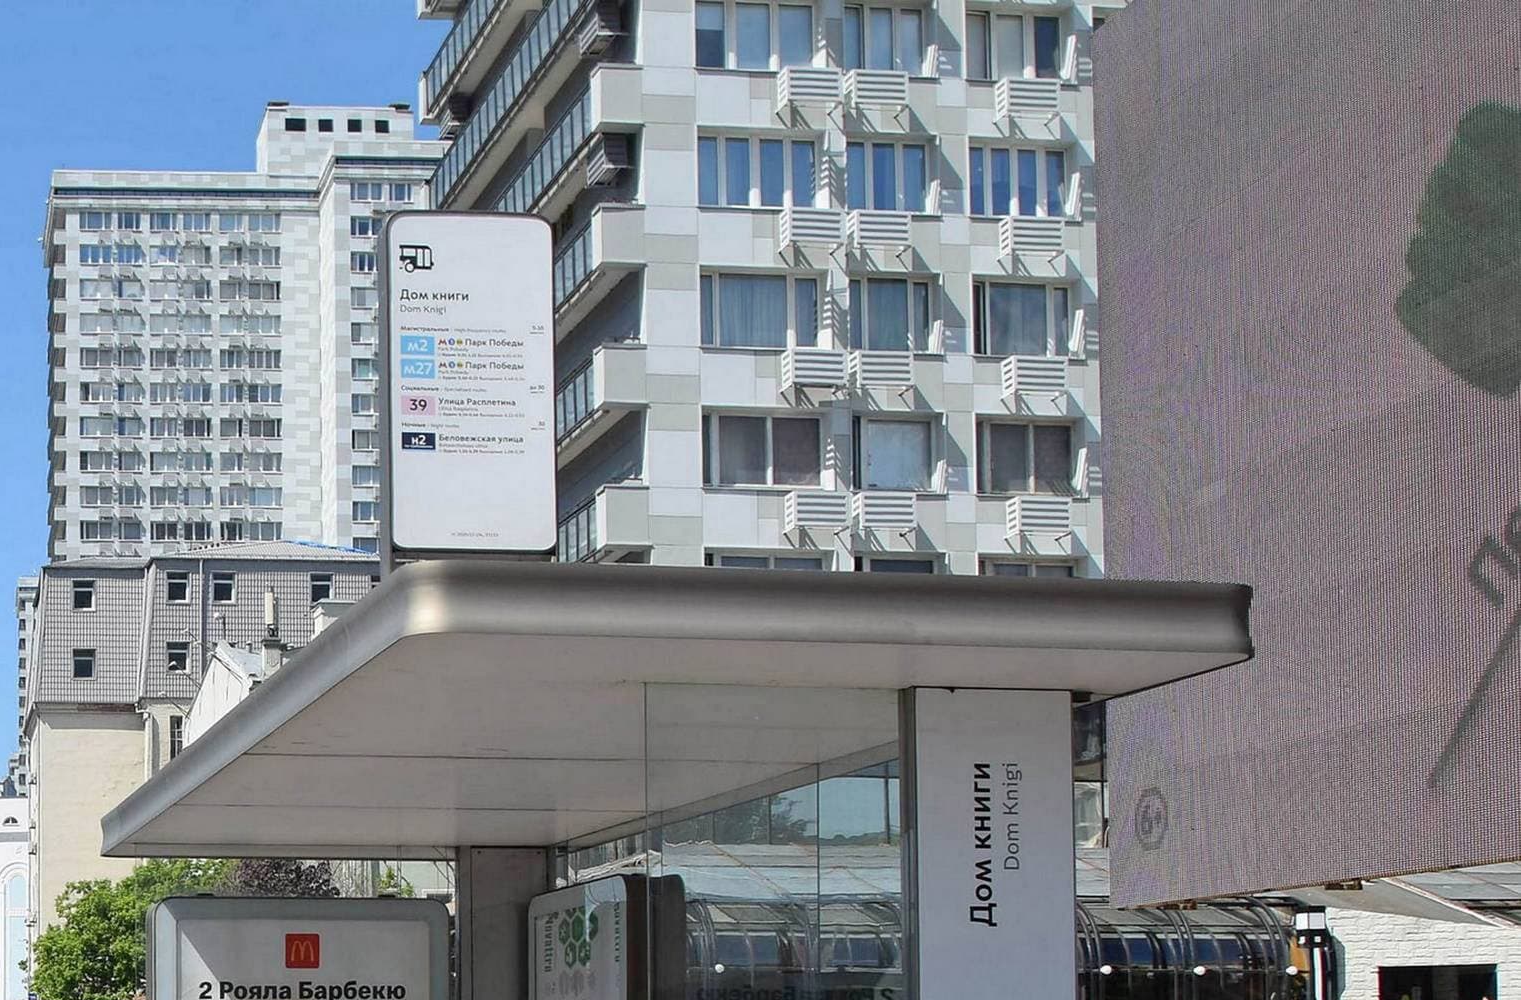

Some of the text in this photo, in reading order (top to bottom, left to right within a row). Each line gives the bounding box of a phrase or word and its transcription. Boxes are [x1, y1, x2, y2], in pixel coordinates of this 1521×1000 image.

[400, 289, 469, 301] Дом книги
[400, 305, 447, 315] Dom Knigi
[489, 339, 524, 347] Победы
[489, 362, 524, 370] Победы
[409, 399, 428, 411] 39
[438, 397, 516, 406] Улица Расплетина
[439, 434, 524, 444] Беловежская улица
[1002, 763, 1022, 870] Dom Knigi
[970, 763, 997, 927] Дом книги
[199, 982, 212, 1000] 2
[219, 981, 292, 1000] Рояла
